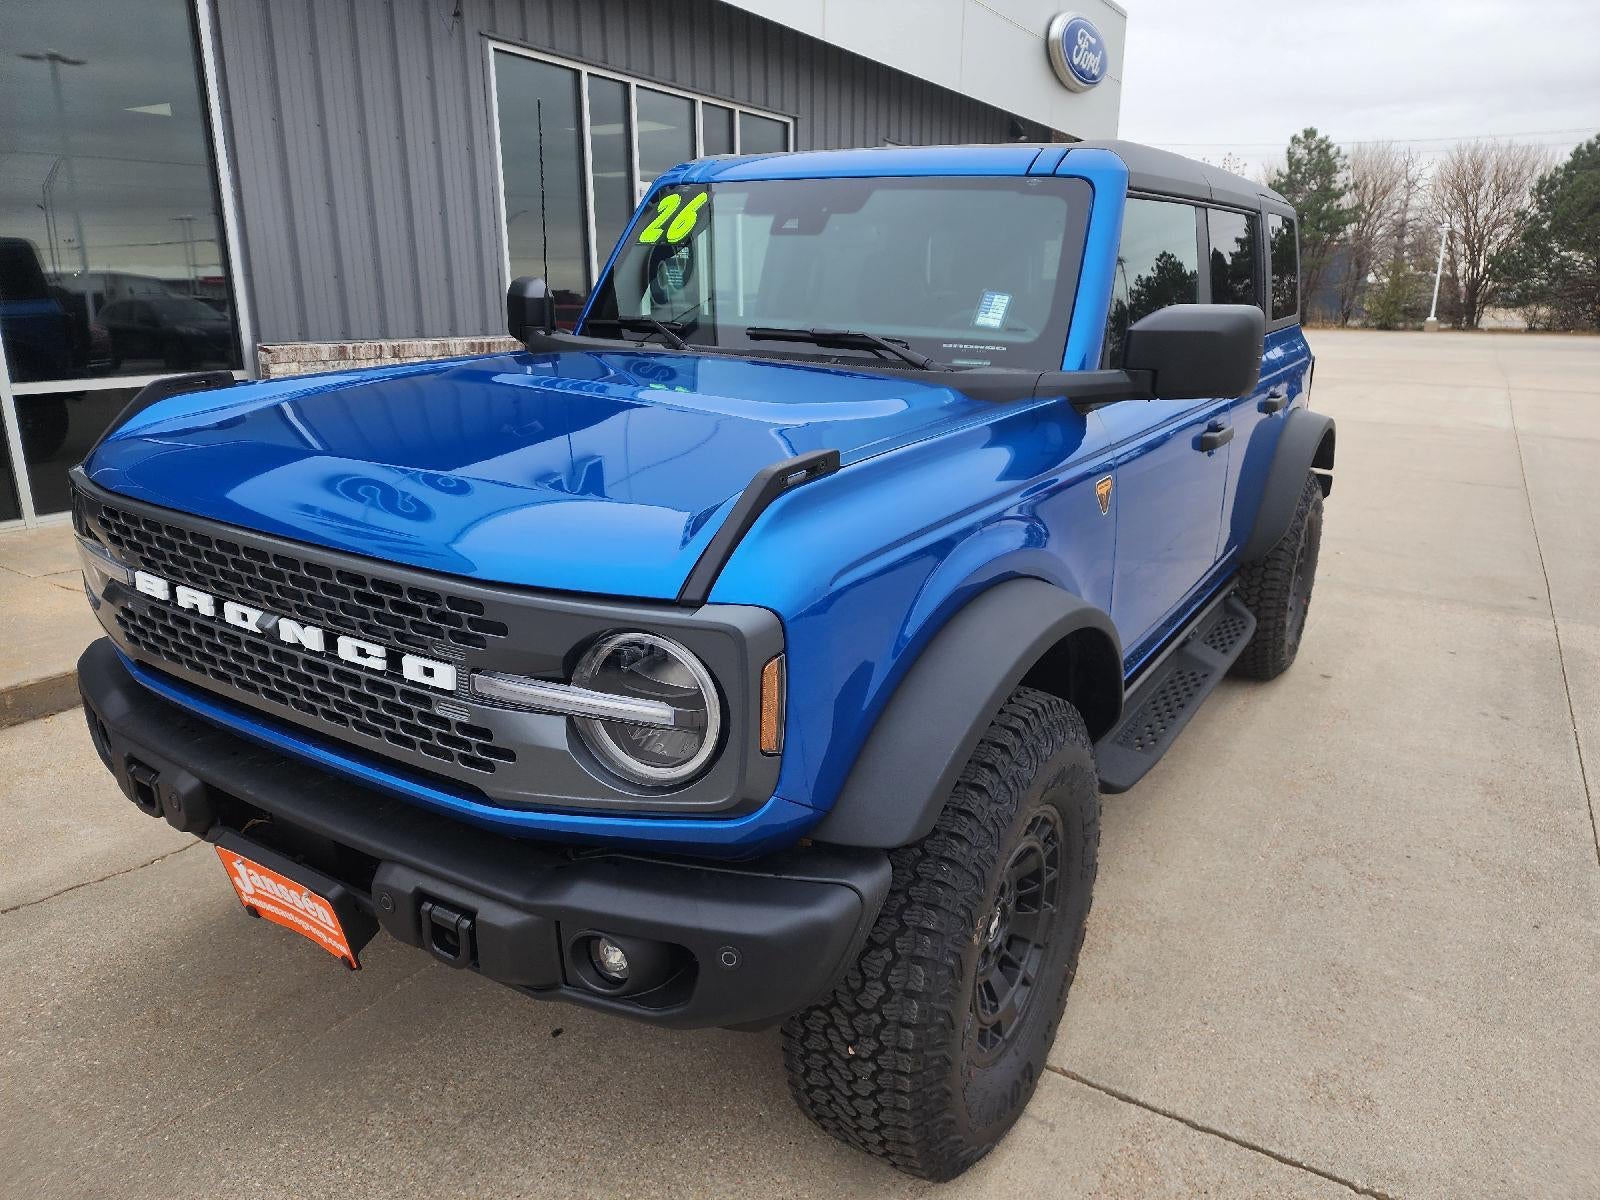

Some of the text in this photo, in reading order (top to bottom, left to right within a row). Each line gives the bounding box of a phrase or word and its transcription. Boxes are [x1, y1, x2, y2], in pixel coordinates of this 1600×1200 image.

[1072, 28, 1102, 76] Ford
[638, 191, 708, 243] 26
[942, 343, 1007, 352] BRONCO
[134, 569, 458, 692] BRONCO
